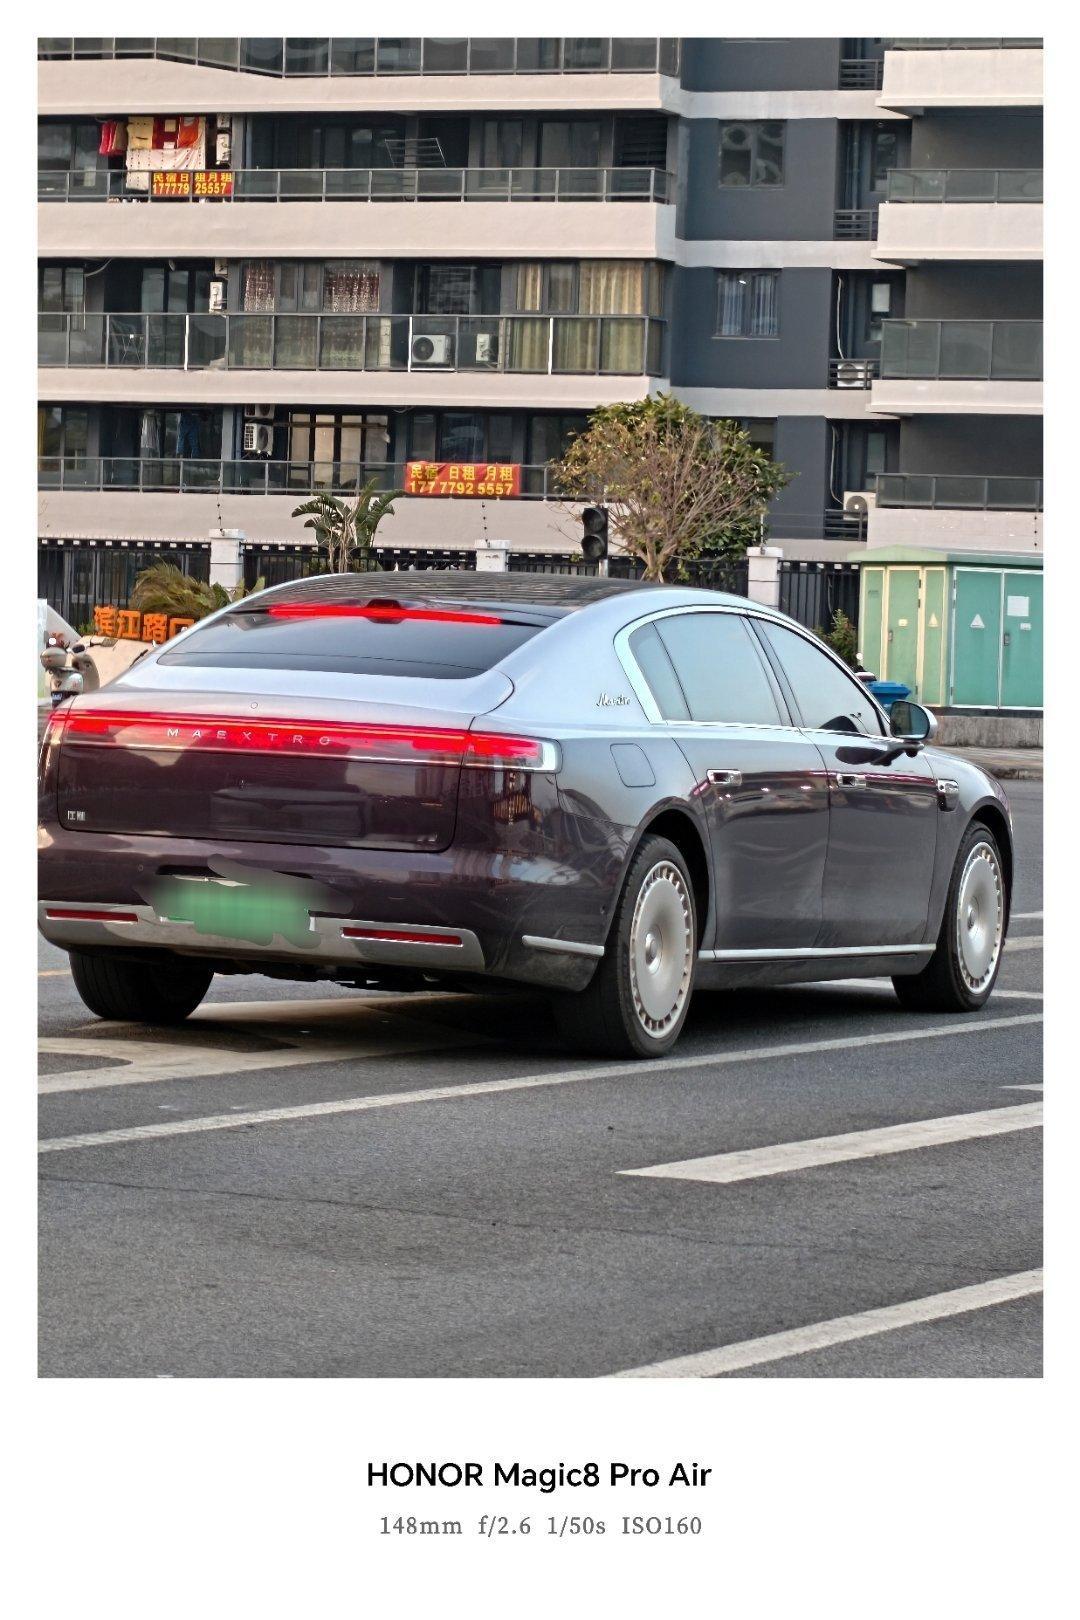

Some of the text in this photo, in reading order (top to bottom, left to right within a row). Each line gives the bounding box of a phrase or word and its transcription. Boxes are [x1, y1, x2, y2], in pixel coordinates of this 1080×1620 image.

[153, 183, 190, 194] 177779
[410, 464, 513, 481] 民宿 日租 月租
[410, 481, 513, 495] 177 7792 5557
[167, 728, 332, 745] MAEXTRO
